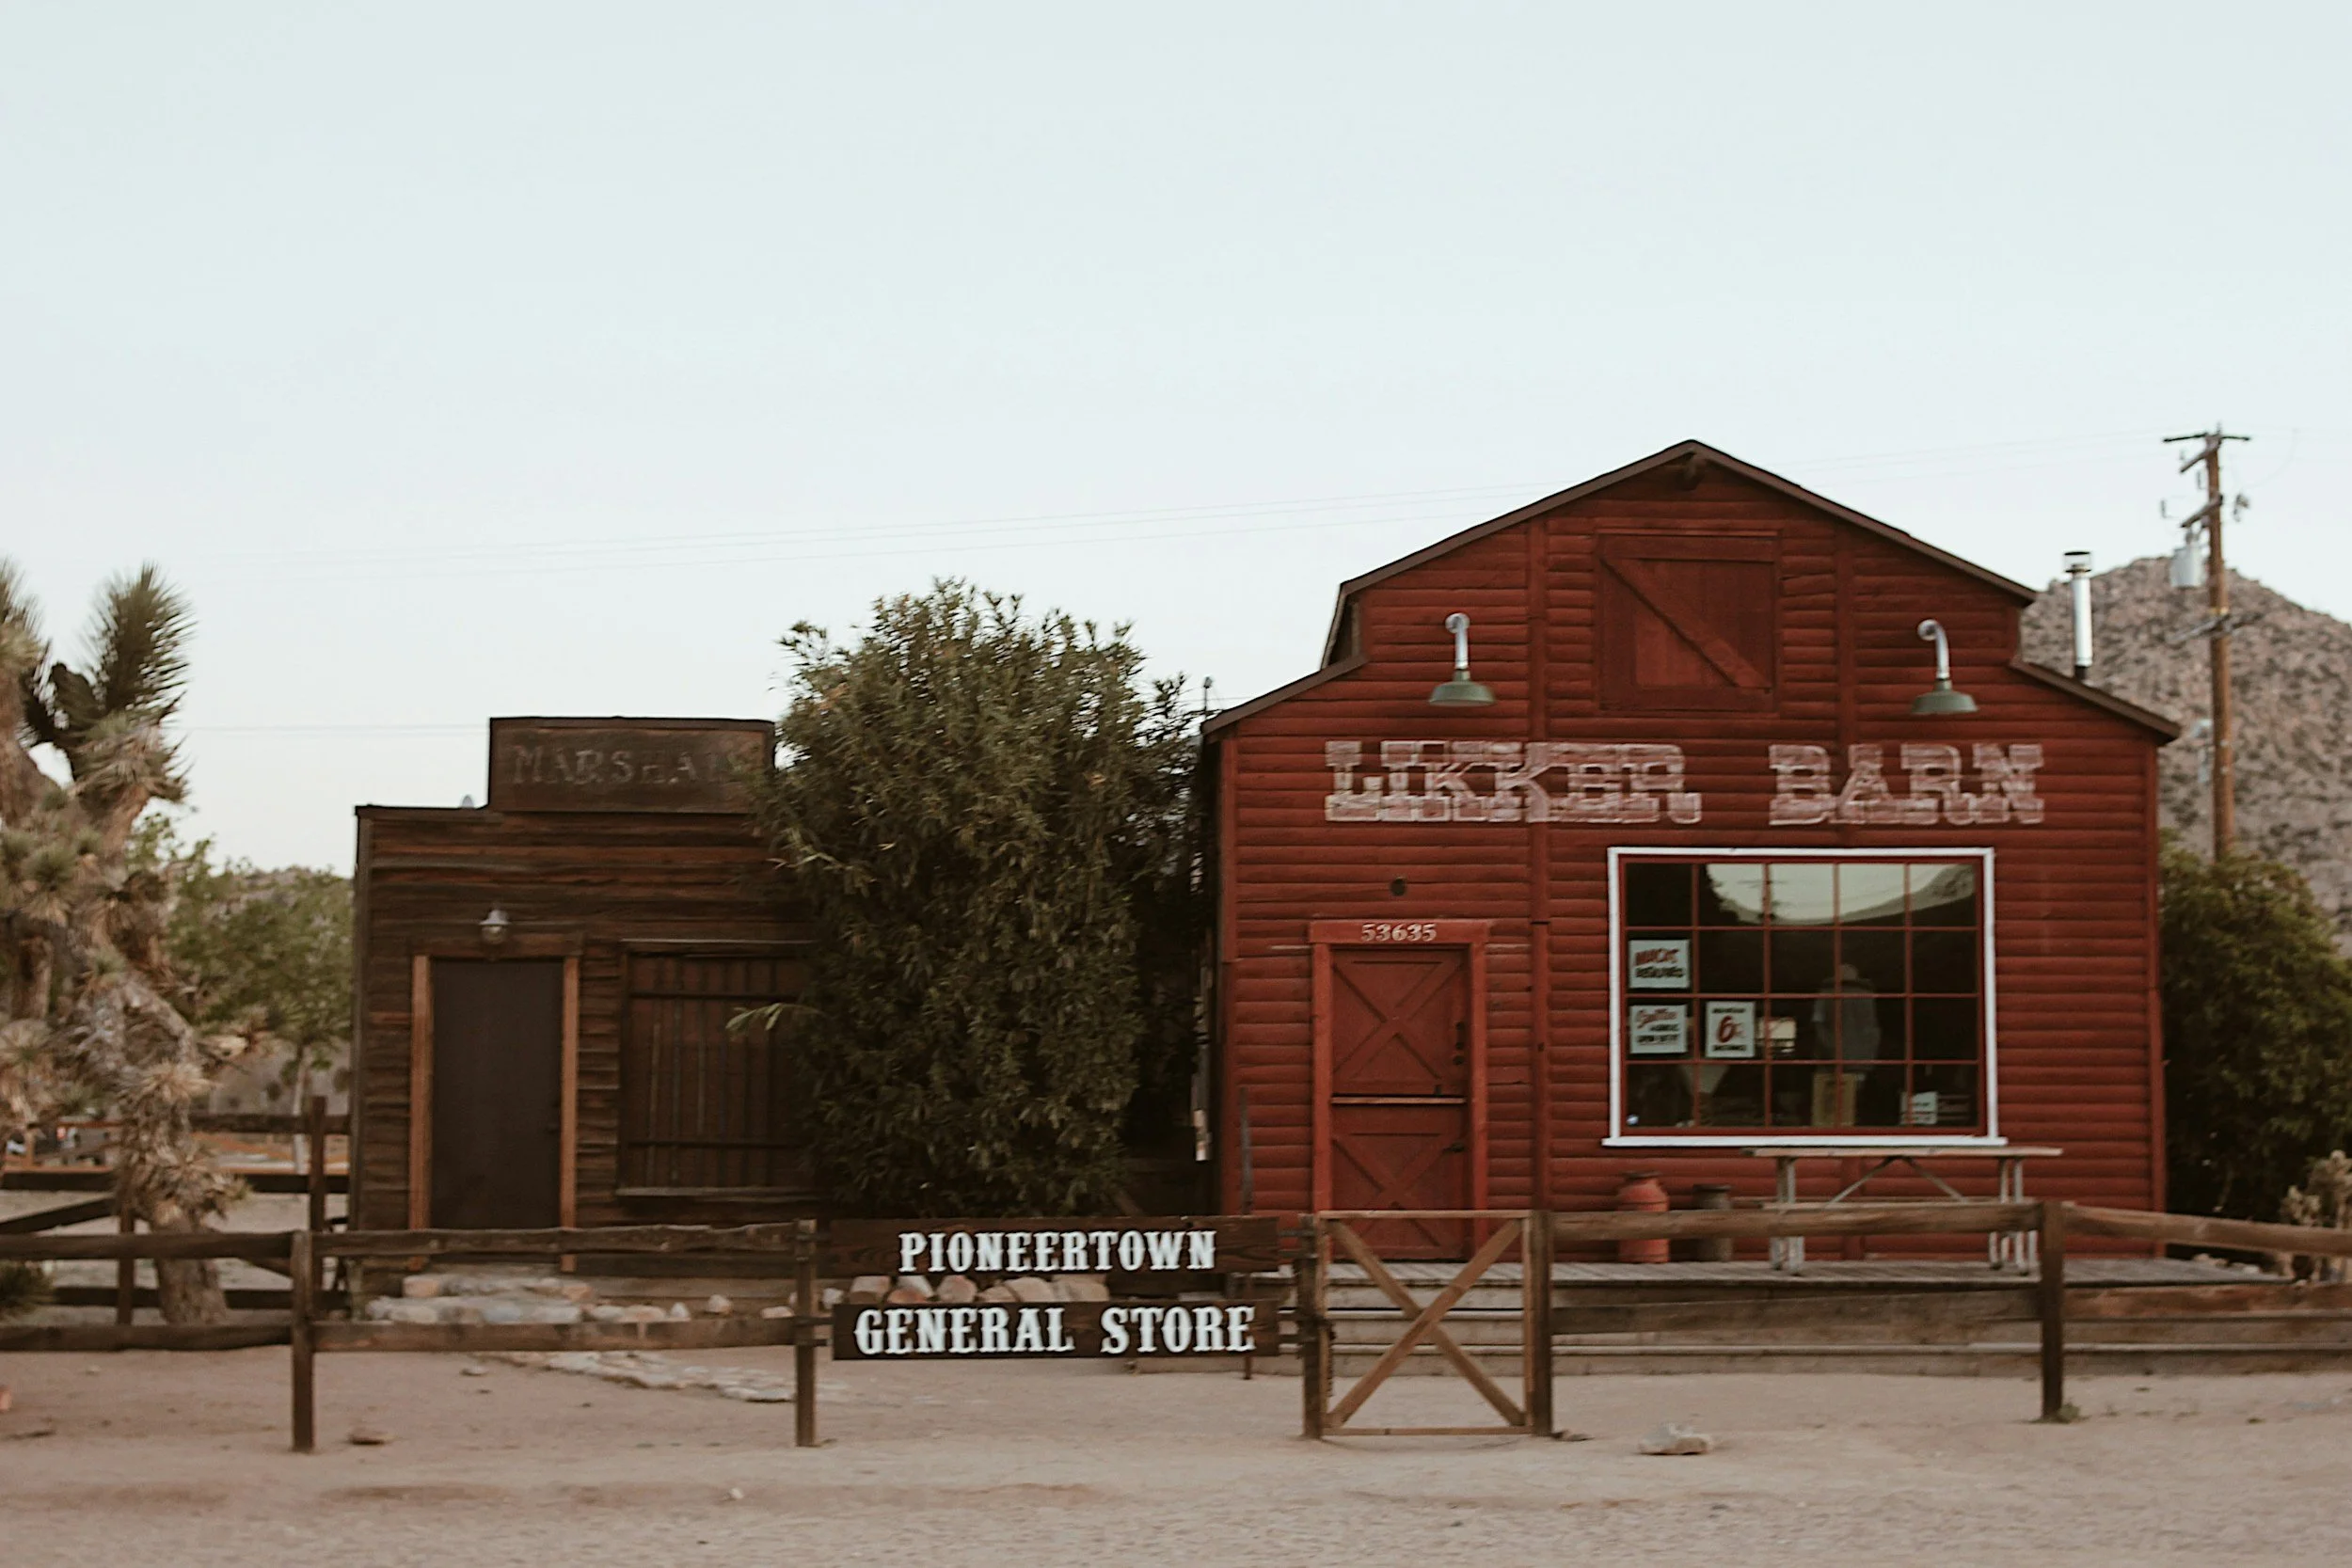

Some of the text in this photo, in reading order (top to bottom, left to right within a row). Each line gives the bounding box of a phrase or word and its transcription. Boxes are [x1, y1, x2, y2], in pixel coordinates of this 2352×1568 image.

[1325, 740, 2045, 827] LIKKER BARN
[1361, 922, 1438, 942] 53635
[898, 1229, 1217, 1273] PIONEERTOWN
[853, 1305, 1257, 1355] GENERAL STORE
